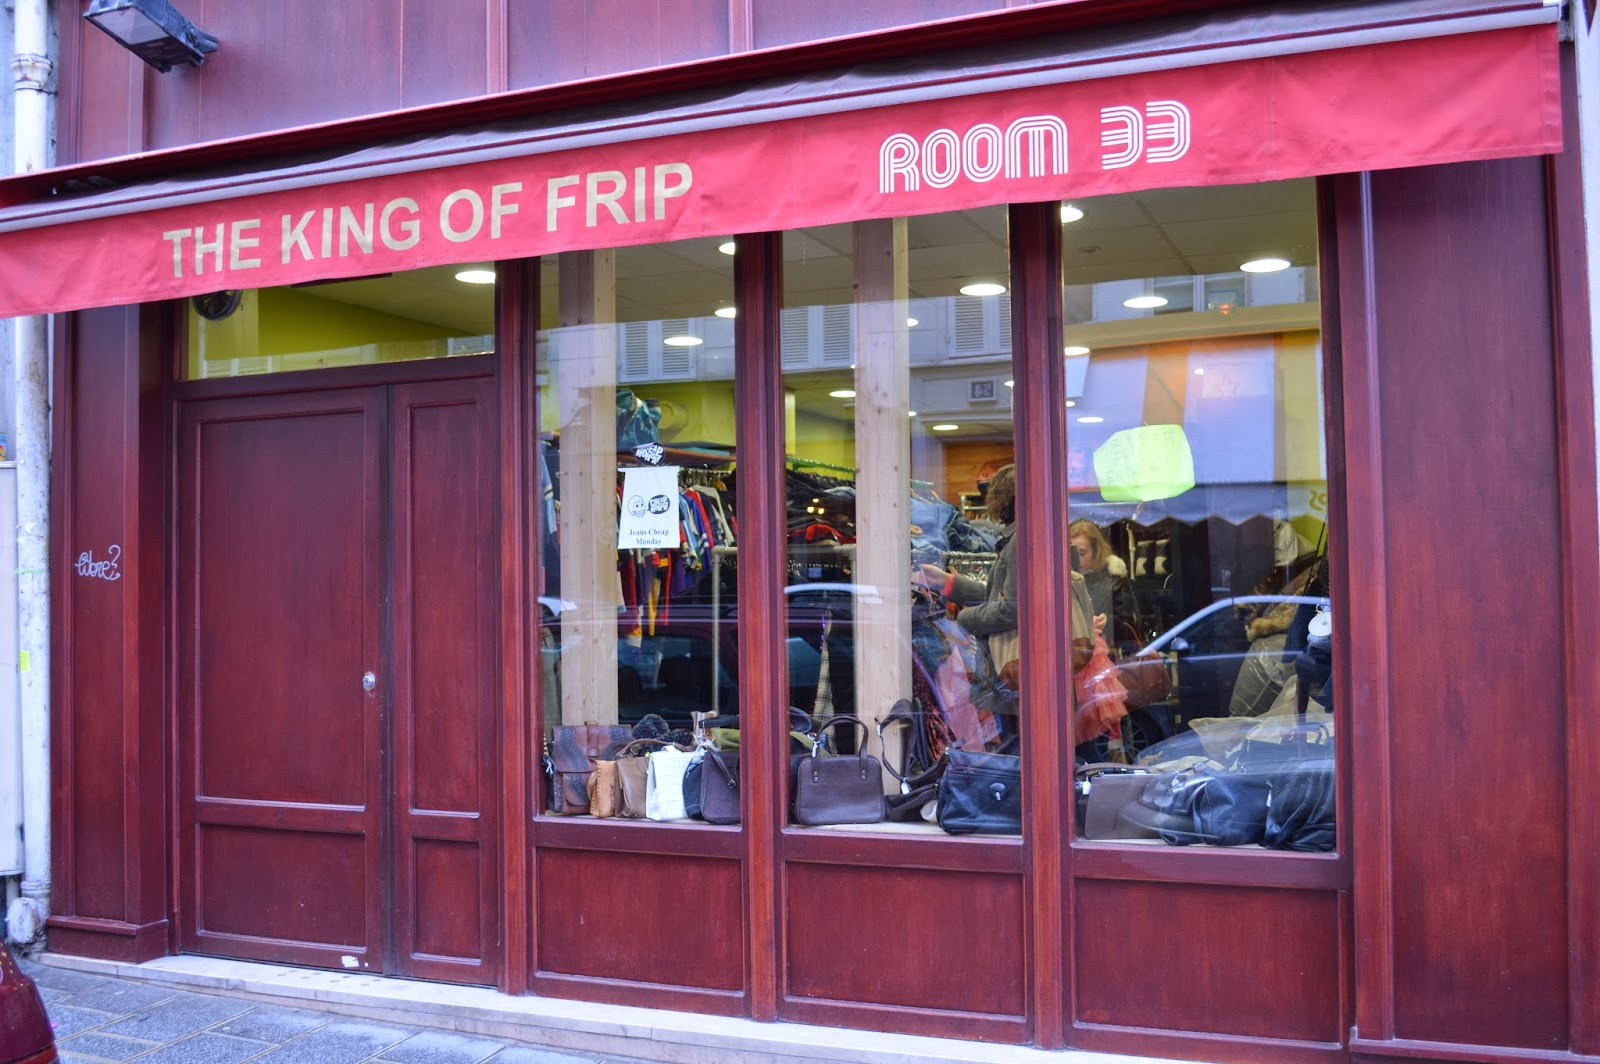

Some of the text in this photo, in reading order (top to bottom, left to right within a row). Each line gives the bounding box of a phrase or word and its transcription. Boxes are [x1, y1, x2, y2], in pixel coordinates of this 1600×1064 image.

[879, 100, 1190, 193] ROOM 33
[162, 162, 694, 278] THE KING OF FRIP
[636, 538, 662, 546] Monday
[648, 528, 670, 537] Cheap
